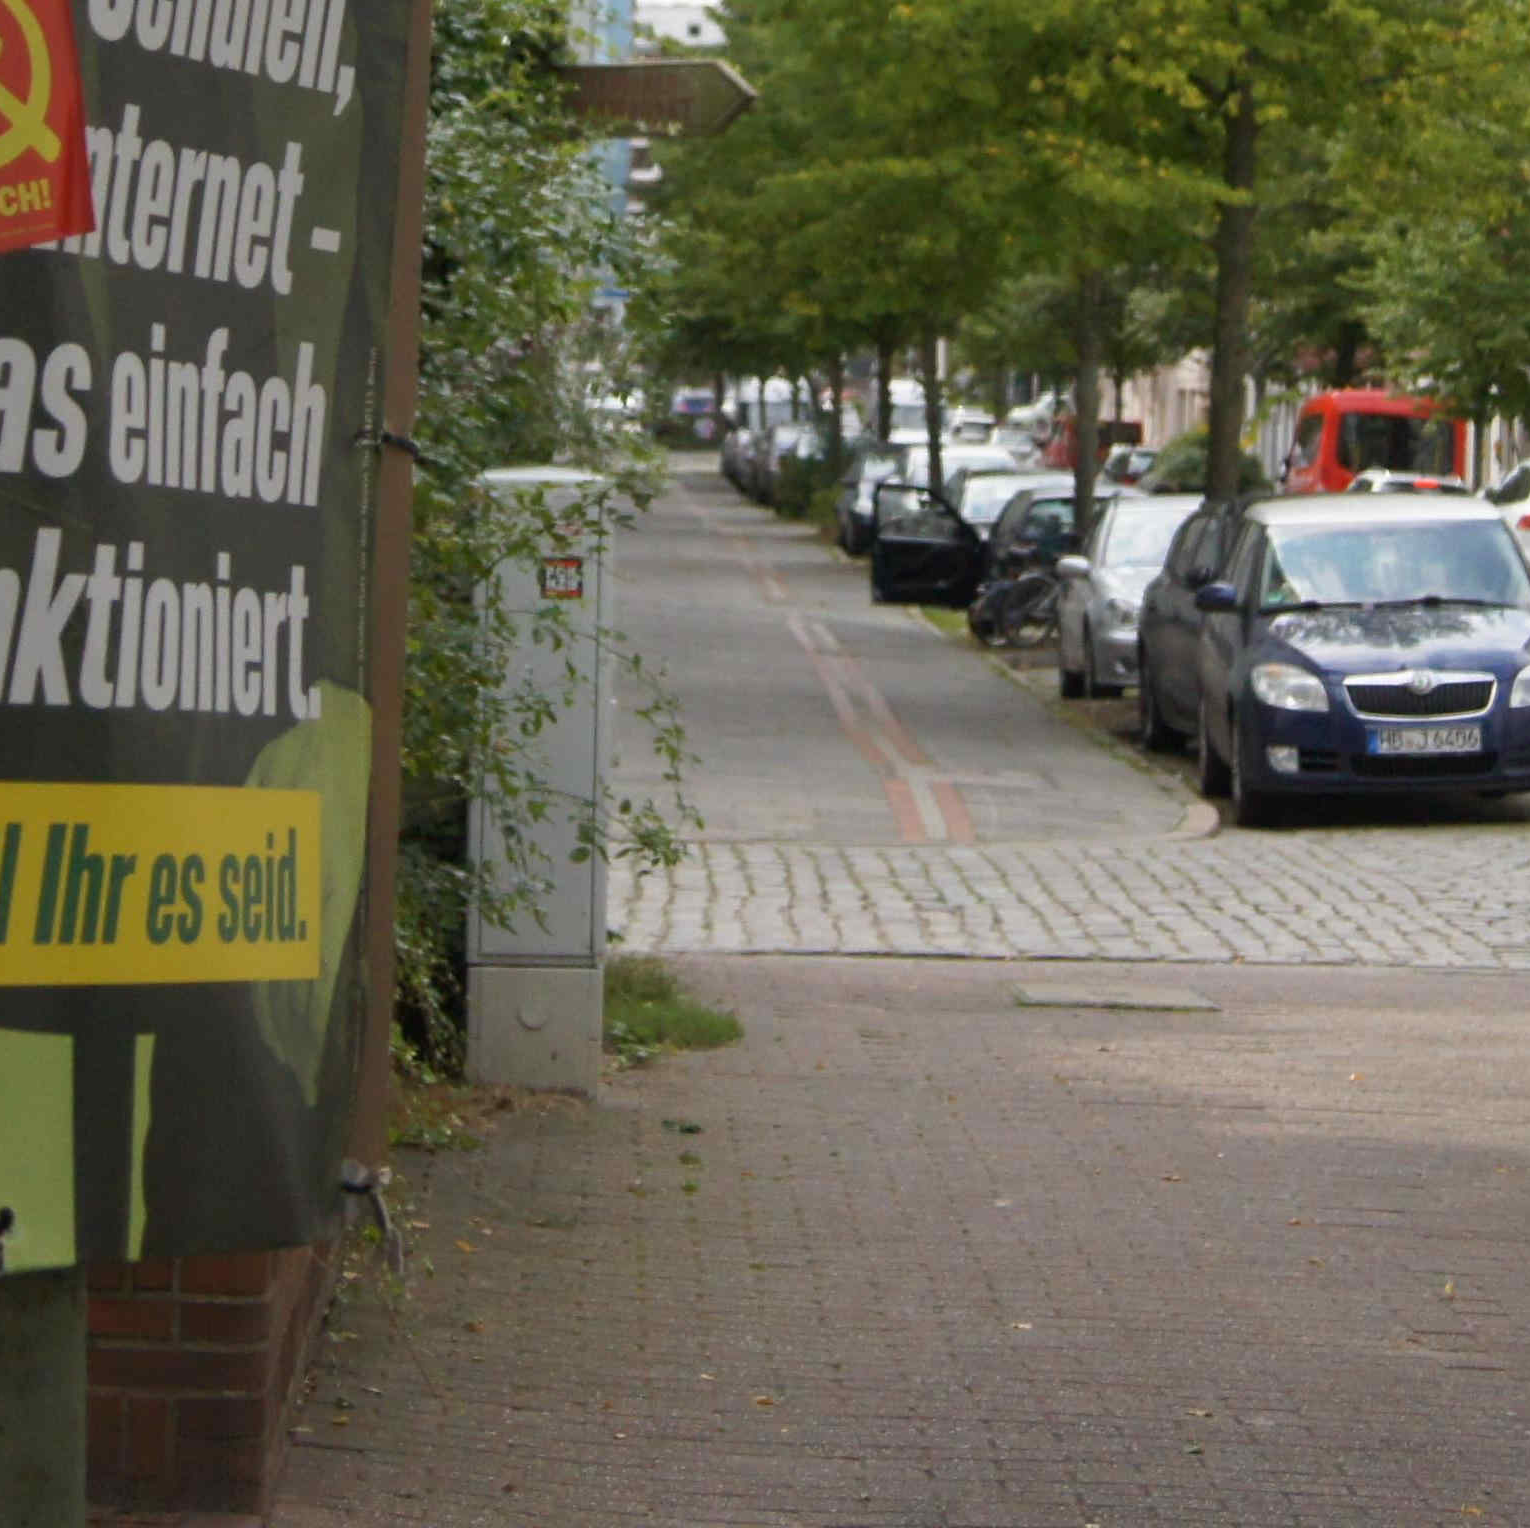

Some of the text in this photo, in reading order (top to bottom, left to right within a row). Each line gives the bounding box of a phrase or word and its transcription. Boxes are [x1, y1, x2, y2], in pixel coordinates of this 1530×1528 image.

[108, 322, 327, 507] einfach
[32, 821, 136, 947] Ihr
[144, 846, 206, 946] es
[216, 826, 308, 944] seid.
